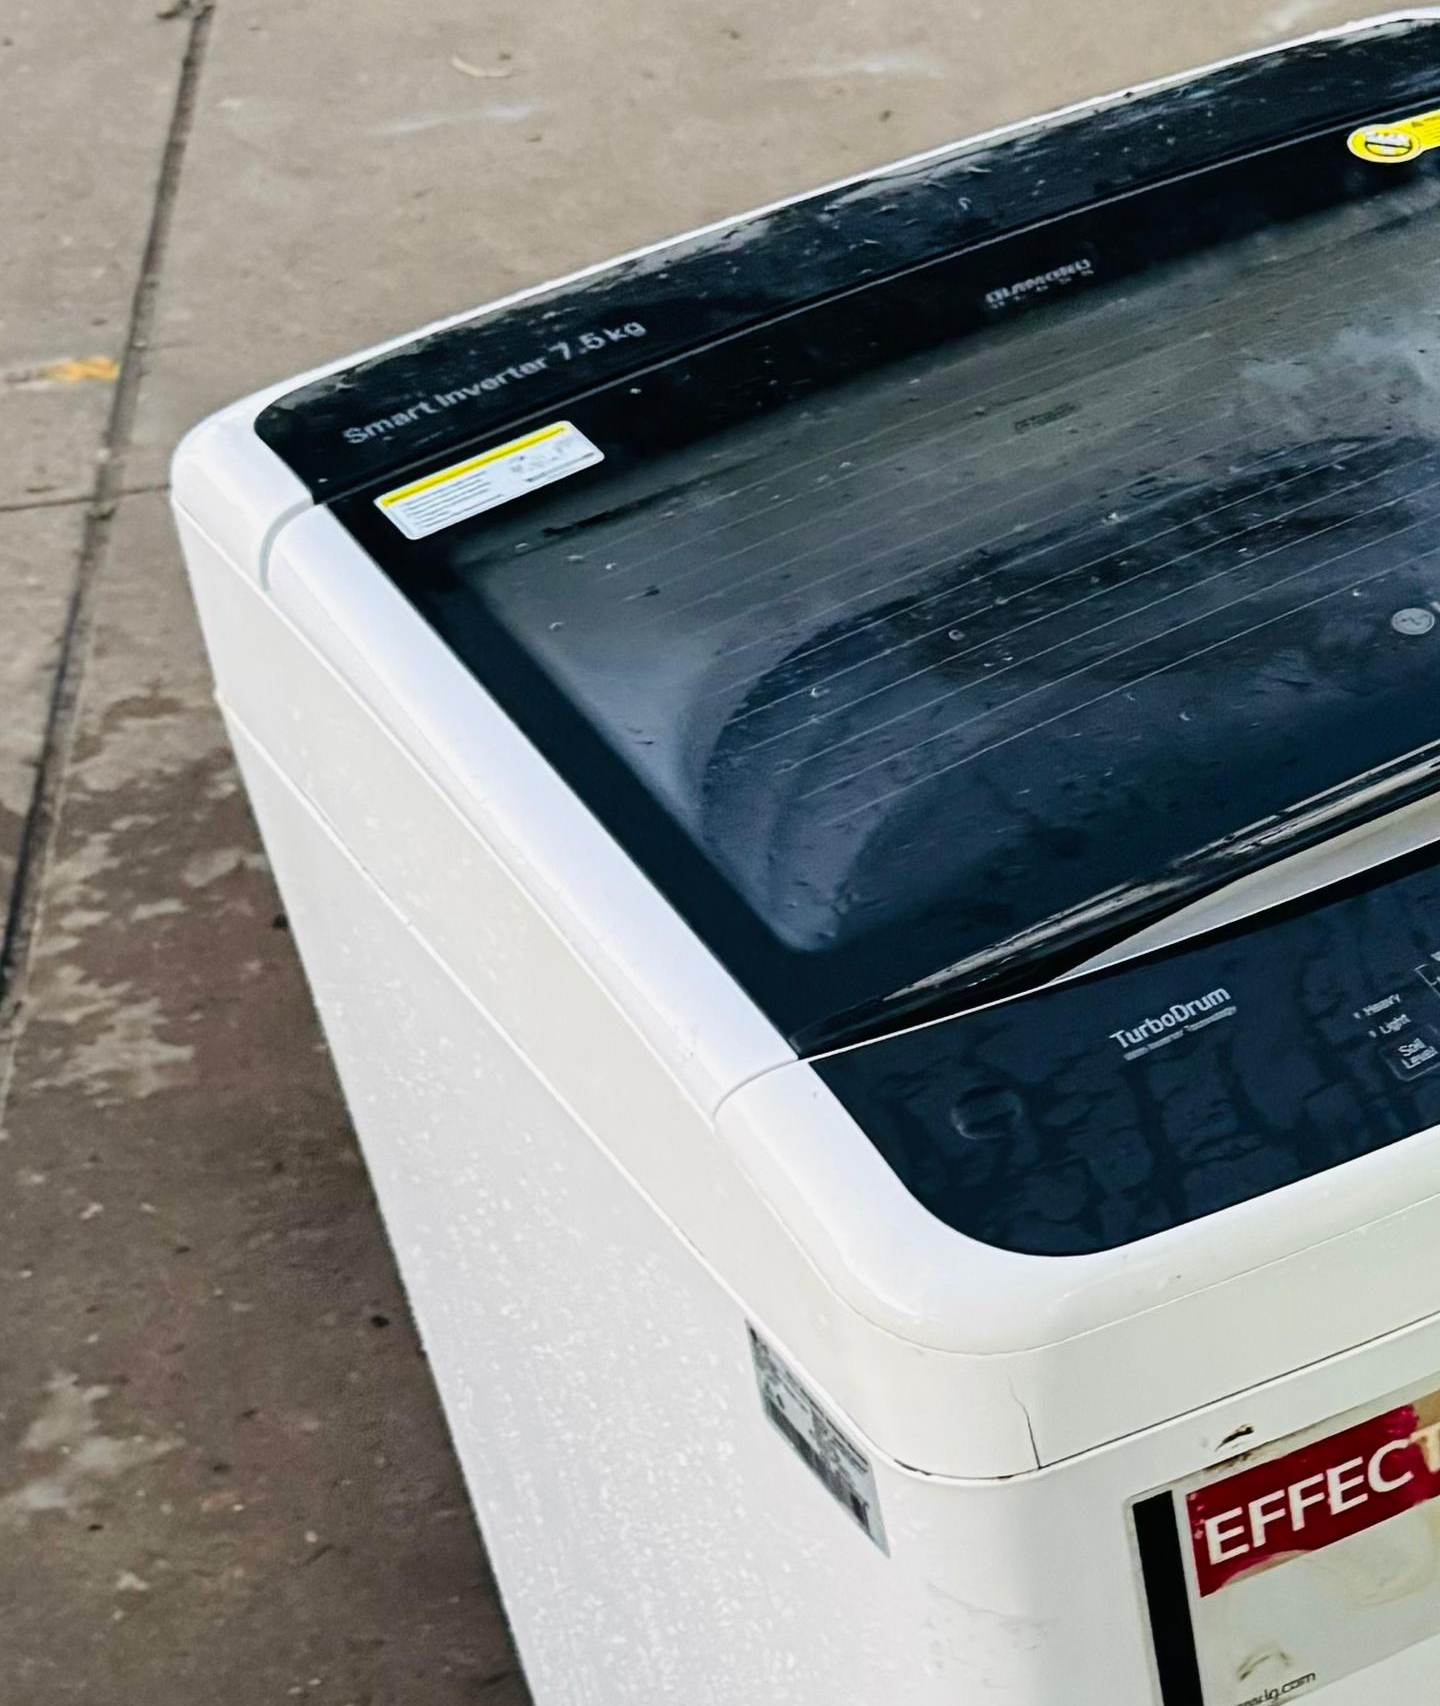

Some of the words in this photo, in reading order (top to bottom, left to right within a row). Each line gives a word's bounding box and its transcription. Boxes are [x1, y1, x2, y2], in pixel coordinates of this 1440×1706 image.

[343, 401, 439, 444] Smart
[437, 356, 549, 409] Inverter
[549, 331, 606, 362] 7.5
[604, 320, 648, 344] kg
[1362, 993, 1402, 1017] Heavy
[1109, 987, 1232, 1049] TurboDrum
[1379, 1014, 1411, 1036] Light
[1398, 1037, 1426, 1058] Soil
[1401, 1045, 1439, 1070] Level
